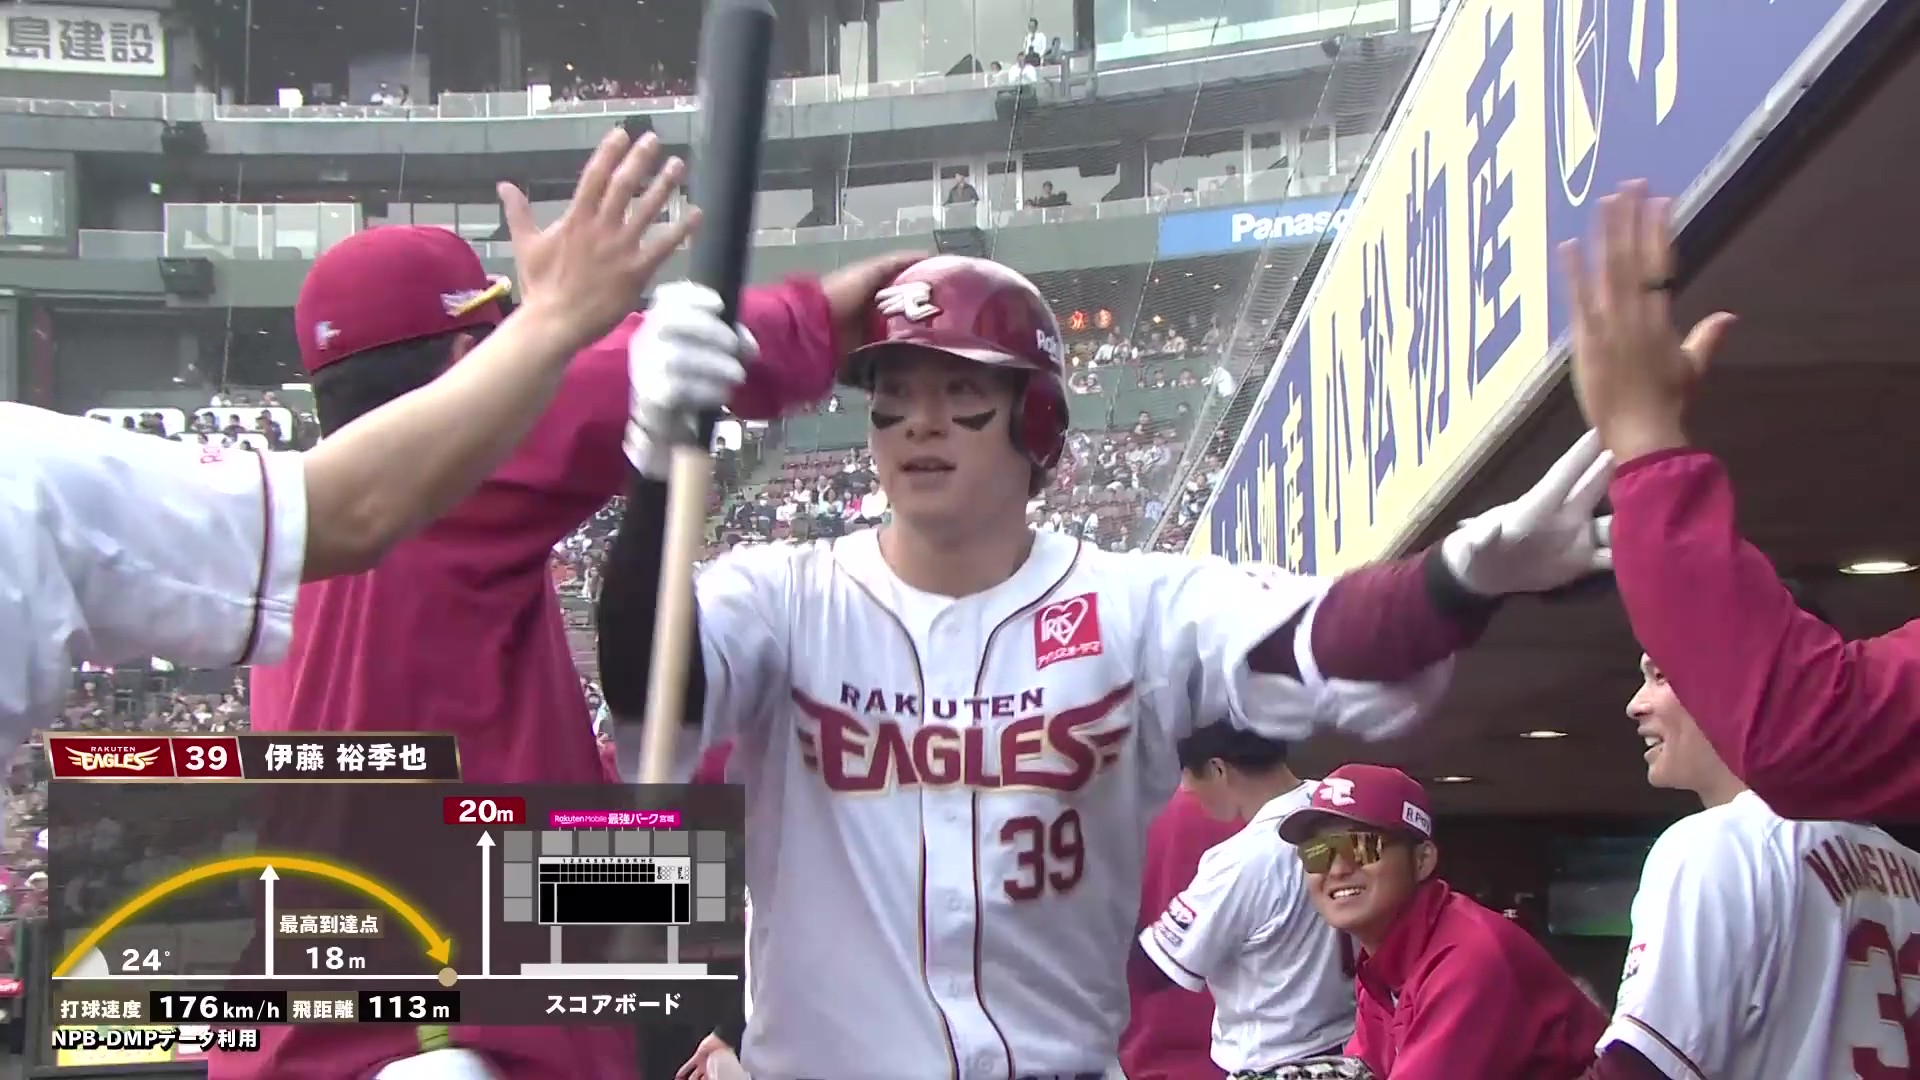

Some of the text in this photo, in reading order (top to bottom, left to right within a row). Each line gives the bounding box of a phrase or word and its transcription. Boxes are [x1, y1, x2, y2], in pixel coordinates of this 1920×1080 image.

[6, 15, 155, 64] 島建設
[1324, 4, 1522, 554] 小松物産
[791, 690, 1130, 793] EAGLES
[840, 681, 1046, 719] RAKUTEN
[999, 808, 1084, 901] 39
